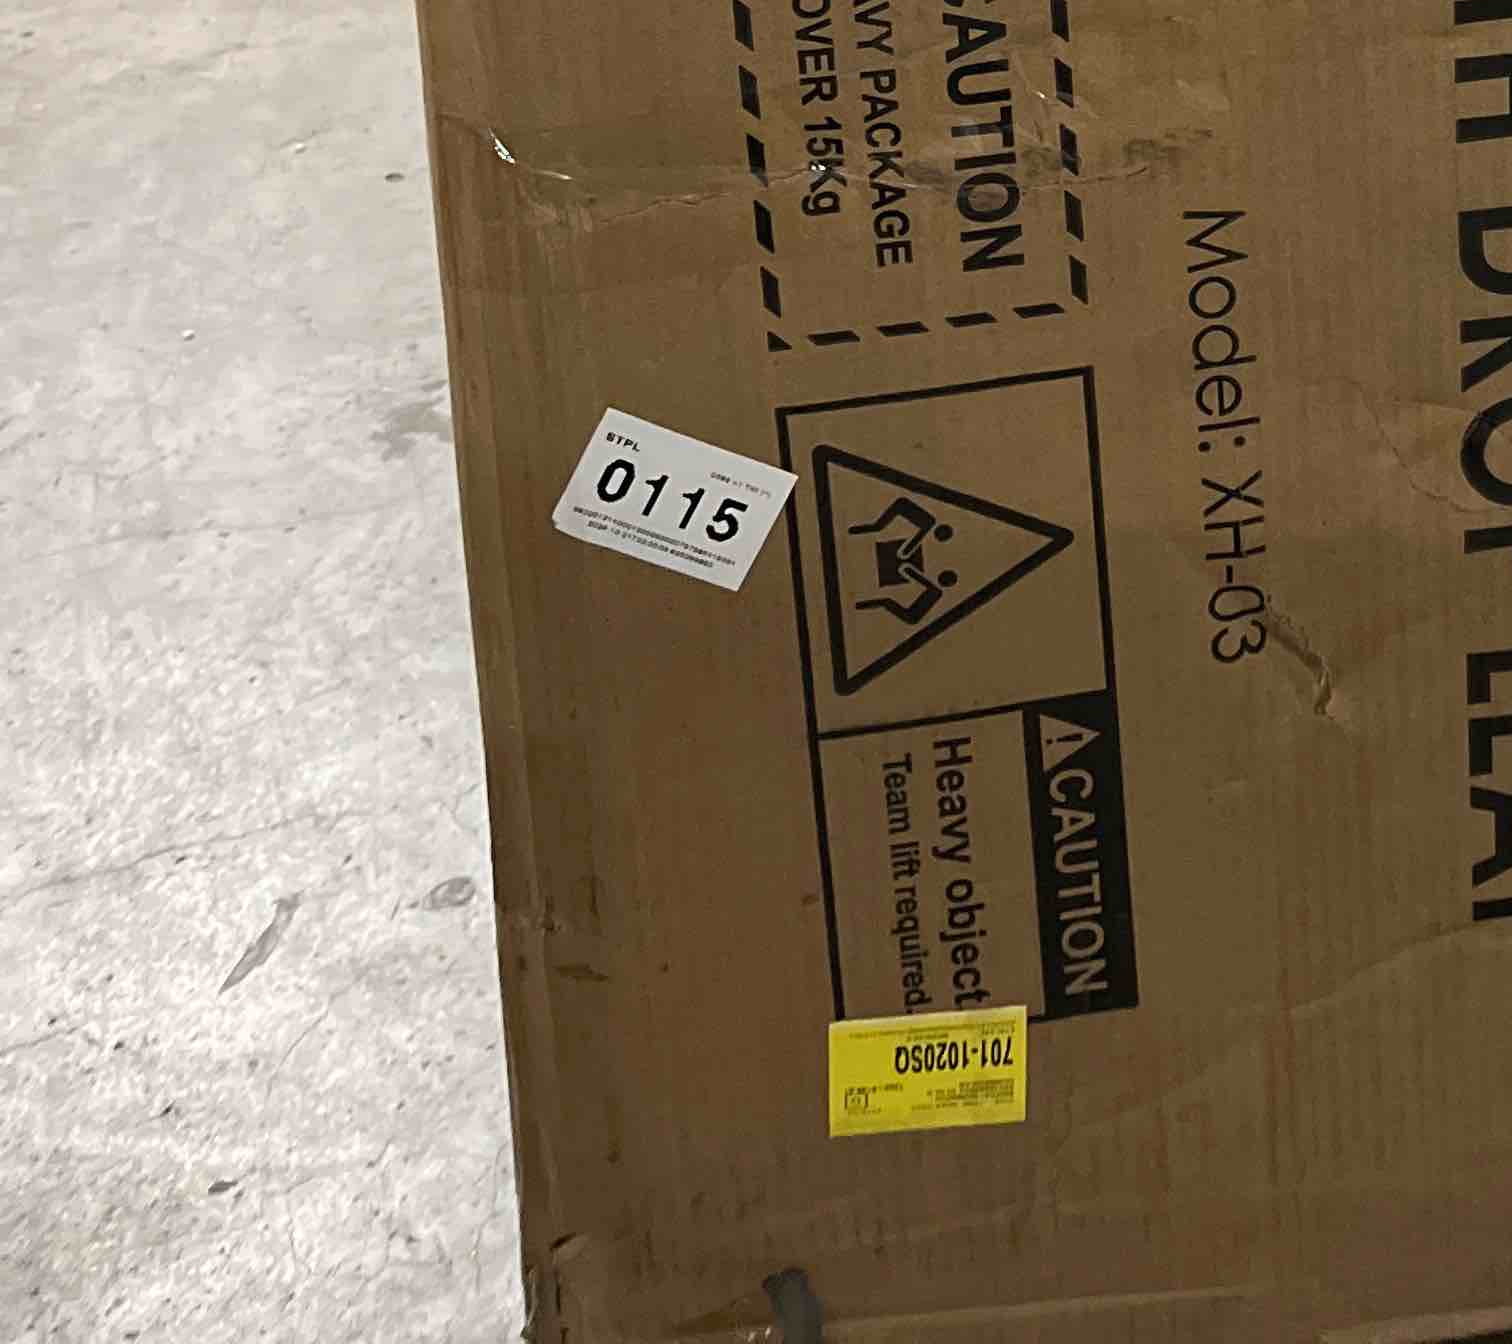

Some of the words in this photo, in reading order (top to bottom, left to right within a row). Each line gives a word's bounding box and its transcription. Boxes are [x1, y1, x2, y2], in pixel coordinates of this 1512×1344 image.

[859, 68, 913, 268] PACKAGE
[1183, 210, 1262, 453] Model:
[596, 458, 749, 543] 0115
[1201, 470, 1267, 664] XH-03
[882, 753, 913, 836] Team
[932, 736, 973, 864] Heavy
[890, 841, 921, 880] lift
[1048, 768, 1108, 996] CAUTION
[939, 878, 992, 1010] object
[894, 1037, 1014, 1075] 701-1020SQ
